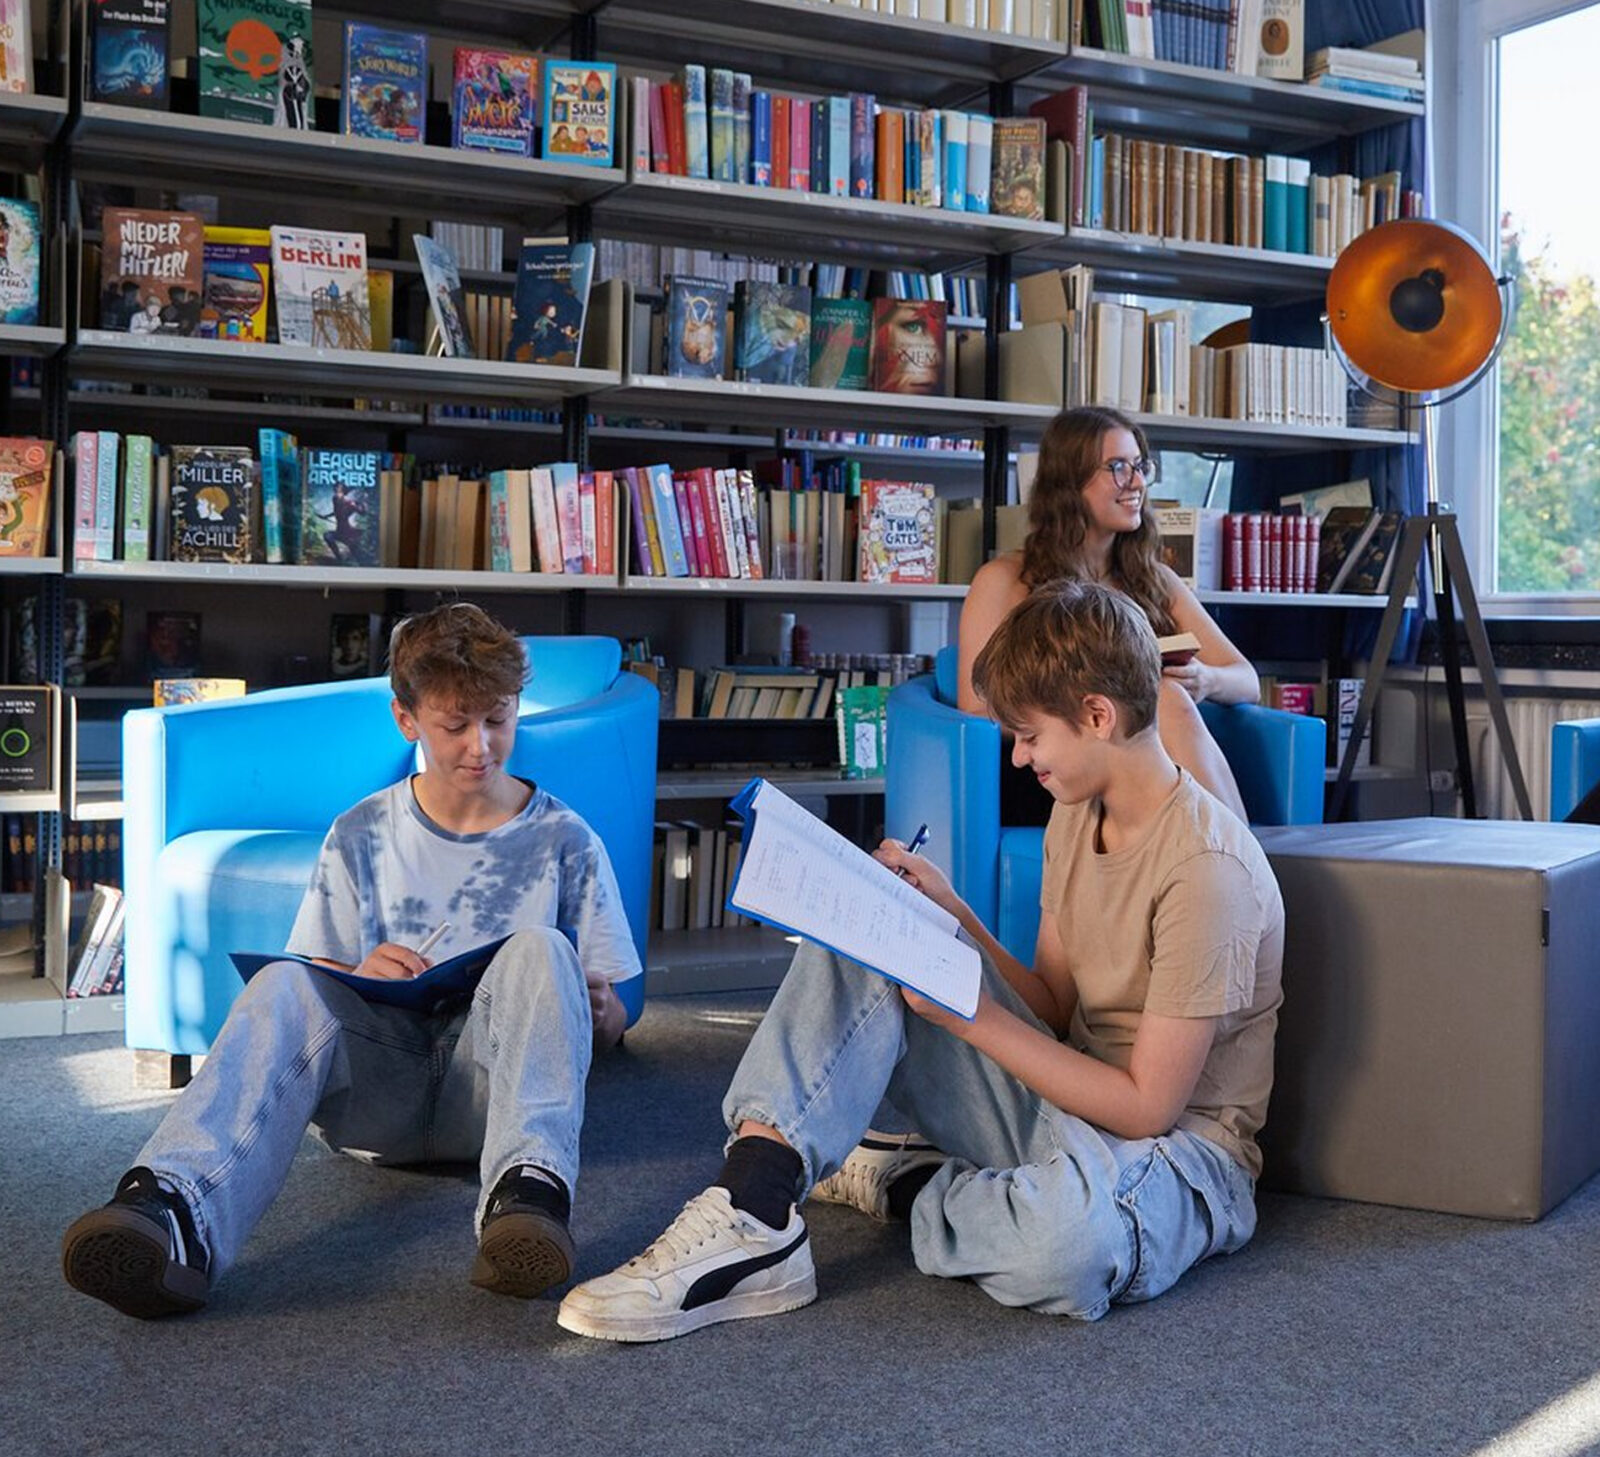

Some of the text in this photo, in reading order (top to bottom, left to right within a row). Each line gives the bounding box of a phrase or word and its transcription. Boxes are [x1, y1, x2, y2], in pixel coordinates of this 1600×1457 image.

[572, 103, 606, 116] SAMS
[120, 219, 181, 246] NIEDER
[121, 241, 155, 259] MIT
[281, 247, 362, 269] BERLIN
[120, 250, 189, 277] HITLER!
[309, 452, 377, 471] LEAGUE
[181, 468, 244, 483] MILLER
[308, 469, 376, 487] ARCHERS
[886, 519, 917, 531] TOM
[181, 532, 241, 547] ACHILL
[885, 532, 919, 545] GATES
